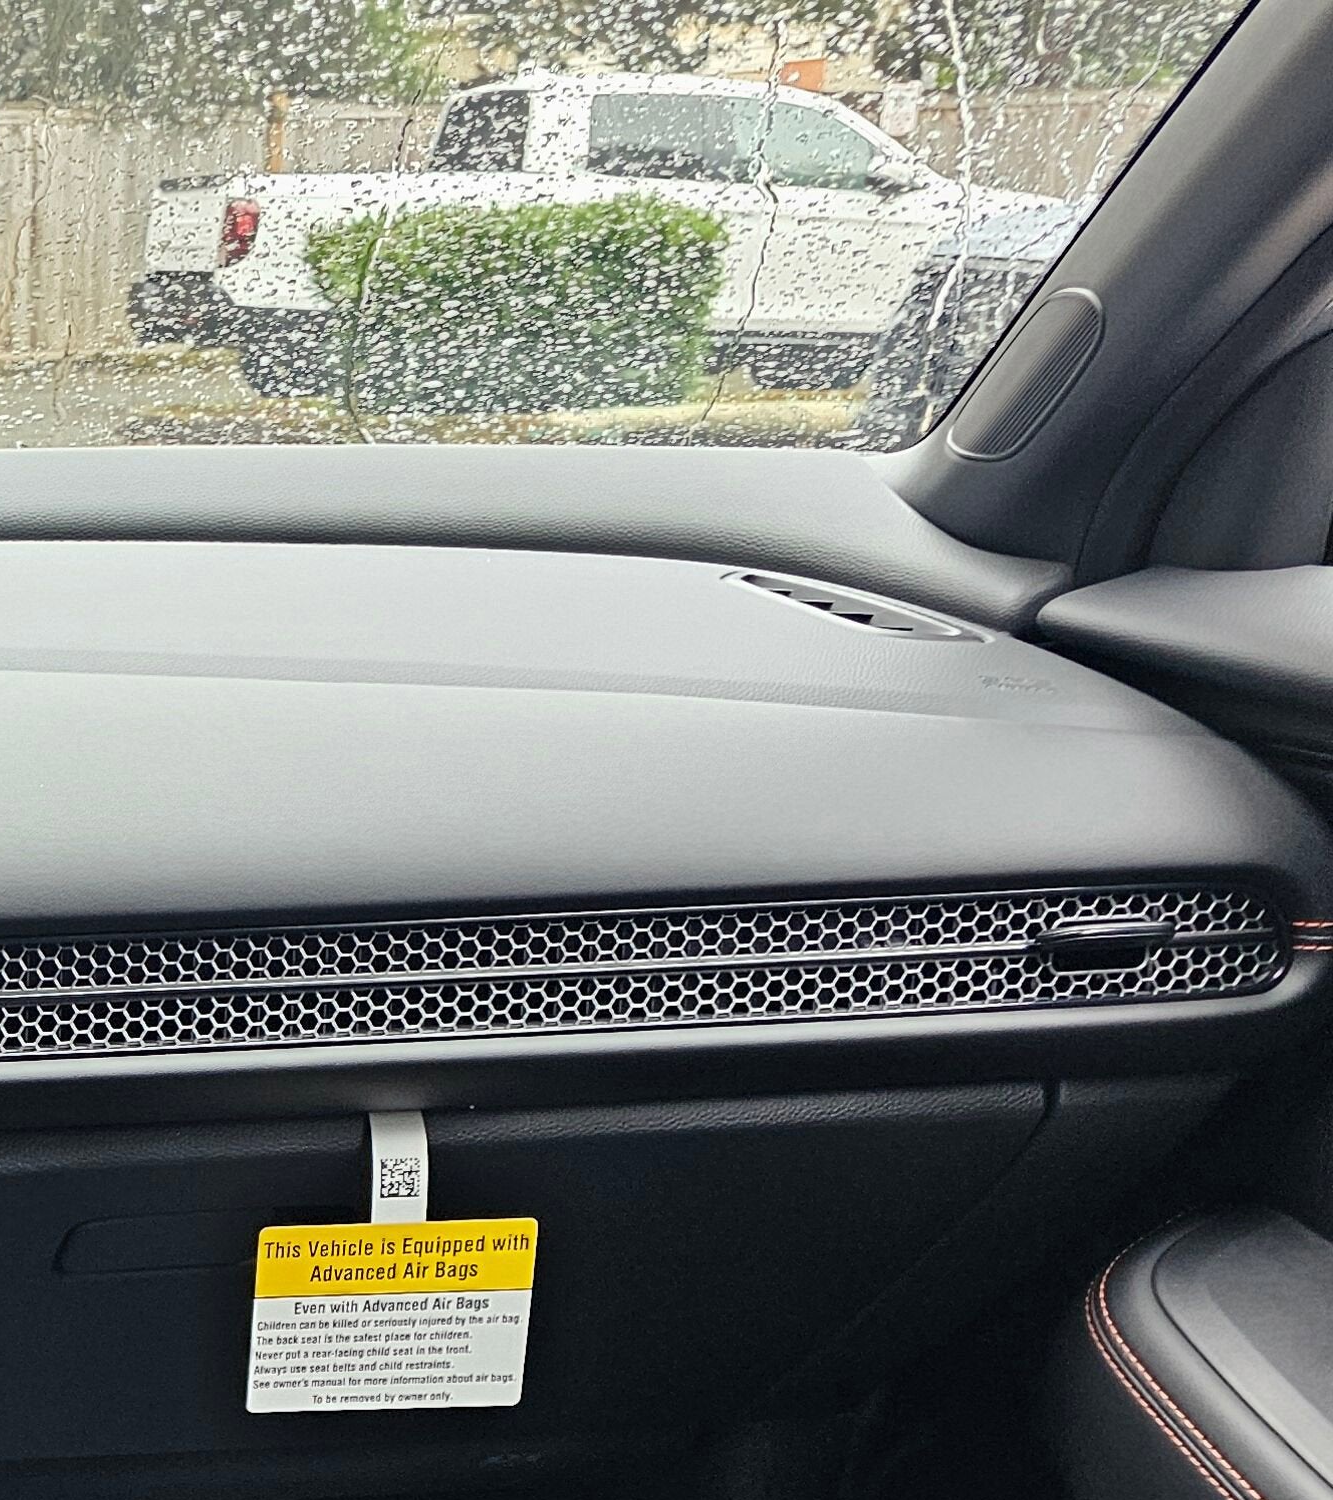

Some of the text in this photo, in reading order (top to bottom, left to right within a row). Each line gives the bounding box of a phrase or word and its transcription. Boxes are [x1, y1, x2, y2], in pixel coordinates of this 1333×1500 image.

[264, 1234, 529, 1259] This Vehicle is Equipped with
[310, 1261, 478, 1282] Advanced Air Bags
[294, 1297, 490, 1315] Even with Advanced Air Bags
[257, 1314, 523, 1331] Children can be killed or seriously injured by the air bag.
[256, 1330, 473, 1346] The back seat is the safest place for children.
[255, 1351, 284, 1361] Never
[285, 1350, 301, 1361] put
[312, 1348, 364, 1359] rear-facing
[366, 1347, 390, 1357] child
[393, 1345, 413, 1356] seat
[416, 1345, 425, 1355] in
[428, 1344, 443, 1354] the
[446, 1344, 472, 1354] front.
[254, 1360, 455, 1376] Always use seat belts and child restraints.
[253, 1373, 517, 1389] See owner's manual for more information about air bags.
[312, 1391, 453, 1405] To be removed by owner only.
